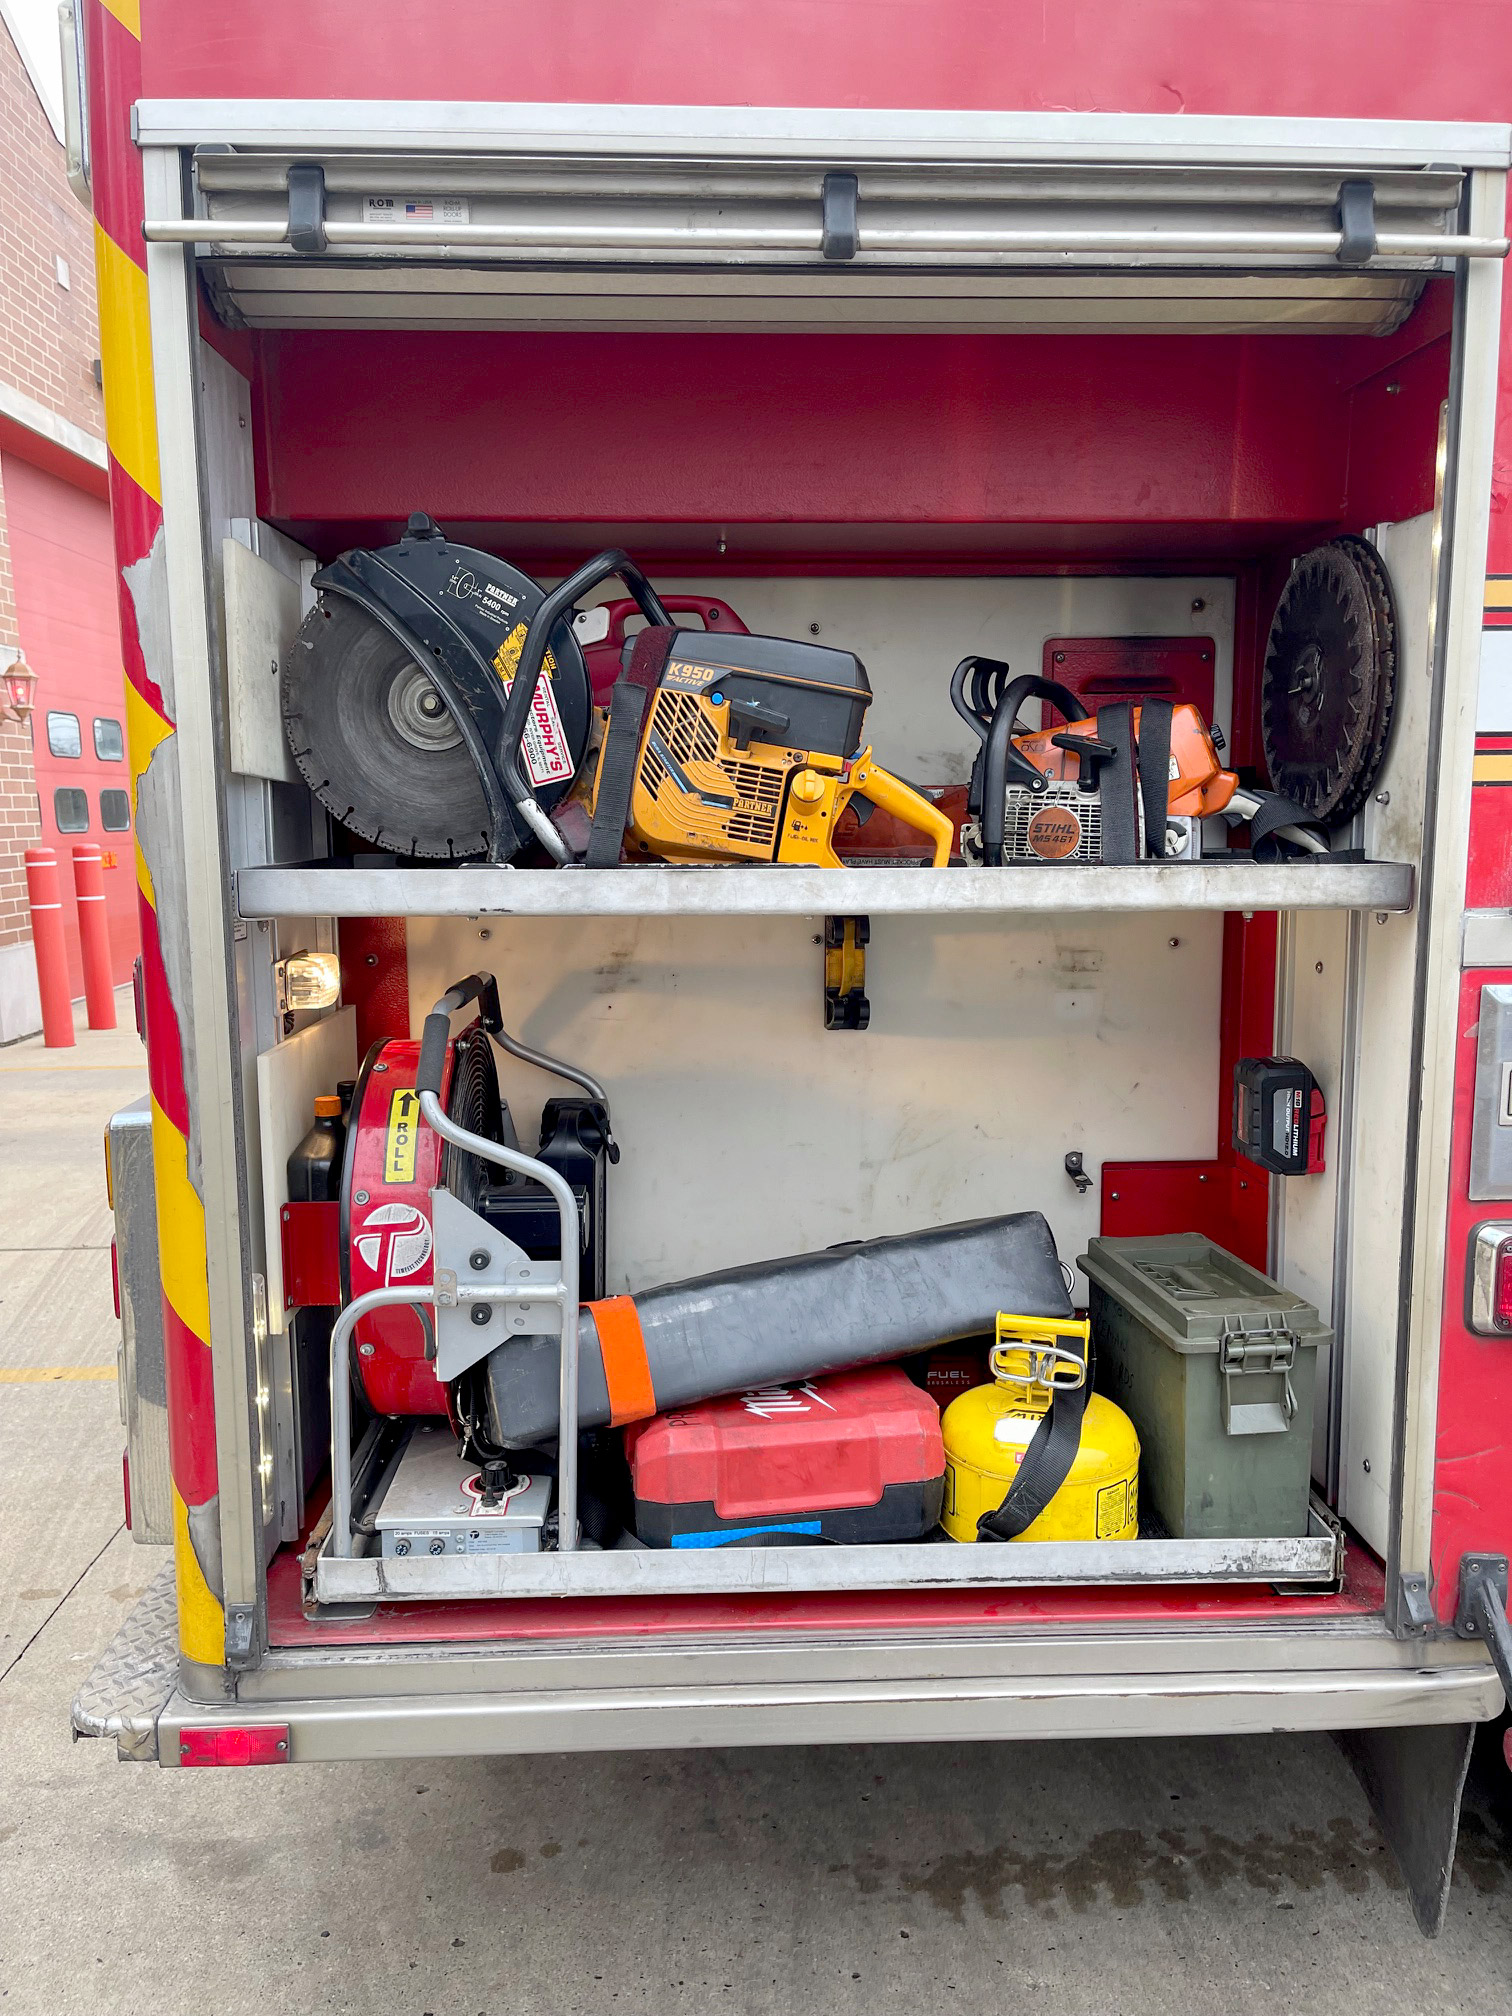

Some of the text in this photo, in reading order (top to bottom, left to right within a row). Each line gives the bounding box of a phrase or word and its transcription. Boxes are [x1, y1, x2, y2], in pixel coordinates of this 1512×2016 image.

[369, 199, 394, 207] ROM
[482, 596, 501, 611] 5400
[485, 583, 519, 606] PARTNER
[673, 677, 704, 686] ACTIVE
[533, 685, 563, 771] MURPHY'S
[536, 735, 550, 774] Equipment
[732, 798, 772, 814] PARTNER
[1033, 823, 1076, 834] STIHL
[393, 1122, 409, 1172] ROLL
[395, 1238, 430, 1275] TEMPEST TECHNOLOGY
